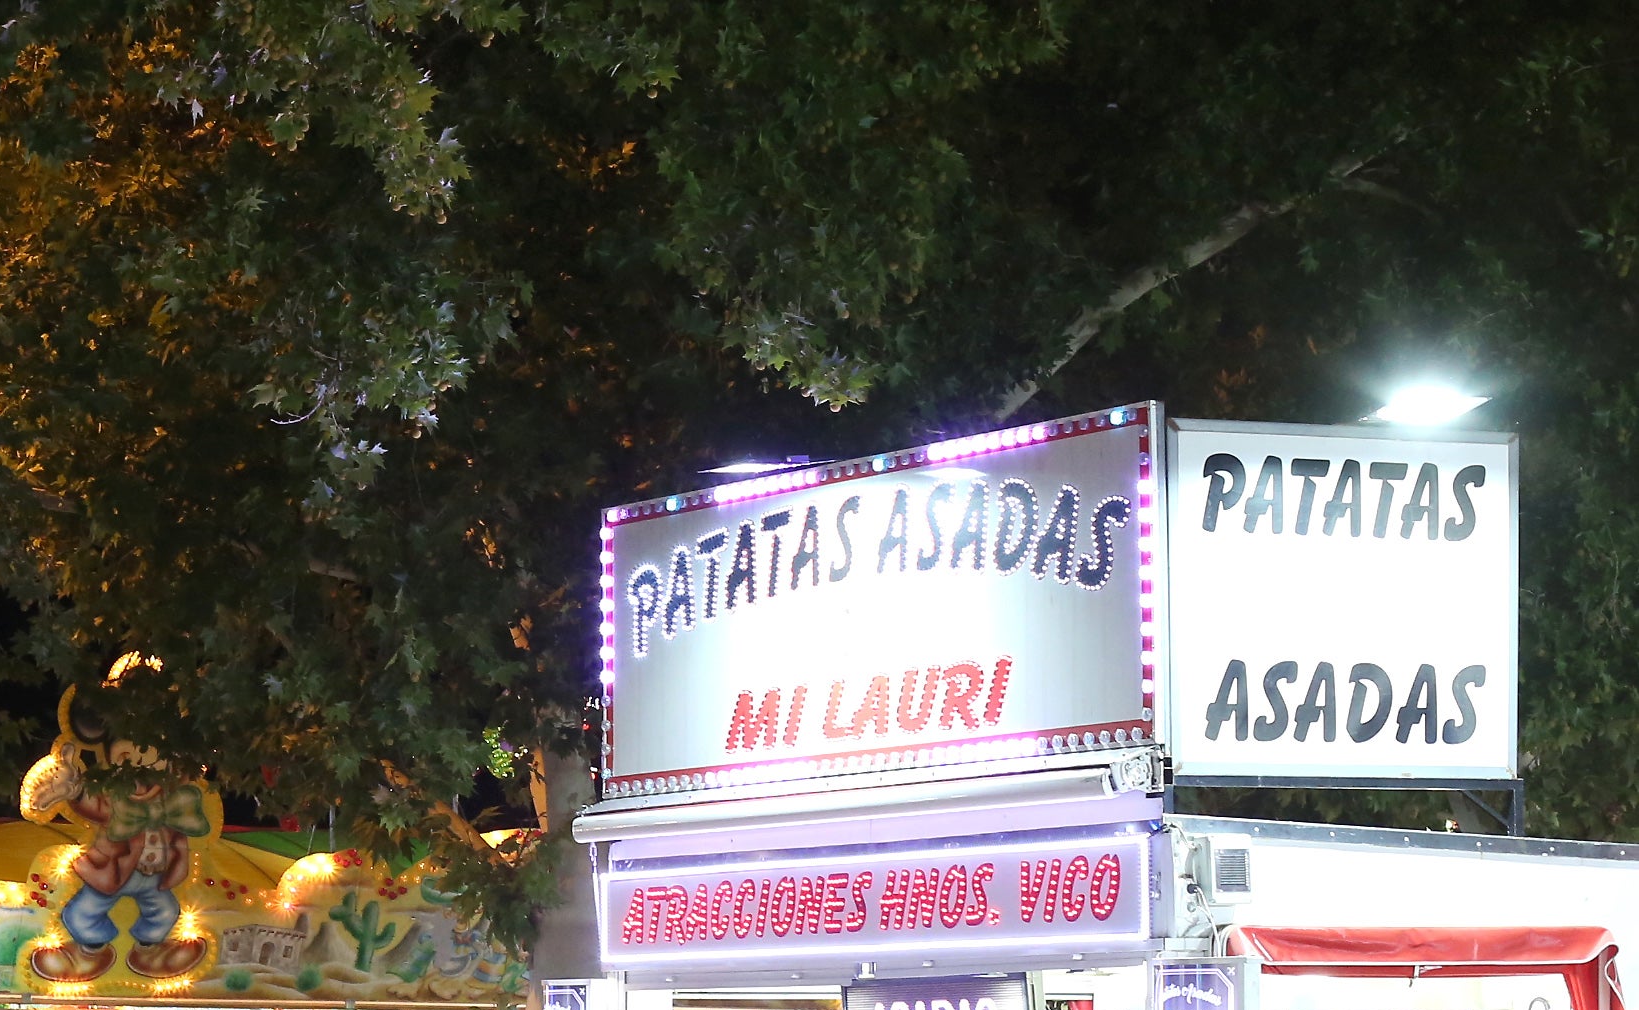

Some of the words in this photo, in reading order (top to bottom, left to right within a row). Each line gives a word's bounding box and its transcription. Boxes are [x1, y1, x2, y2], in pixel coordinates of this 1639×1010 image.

[1202, 453, 1486, 541] PATATAS
[626, 495, 861, 659] PATATAS
[878, 477, 1132, 591] ASADAS
[725, 683, 808, 754] MI
[822, 654, 1013, 740] LAURI
[1204, 659, 1486, 744] ASADAS
[621, 871, 873, 945] ATRACCIONES
[879, 862, 1000, 931] HNOS.
[1019, 853, 1122, 922] VICO
